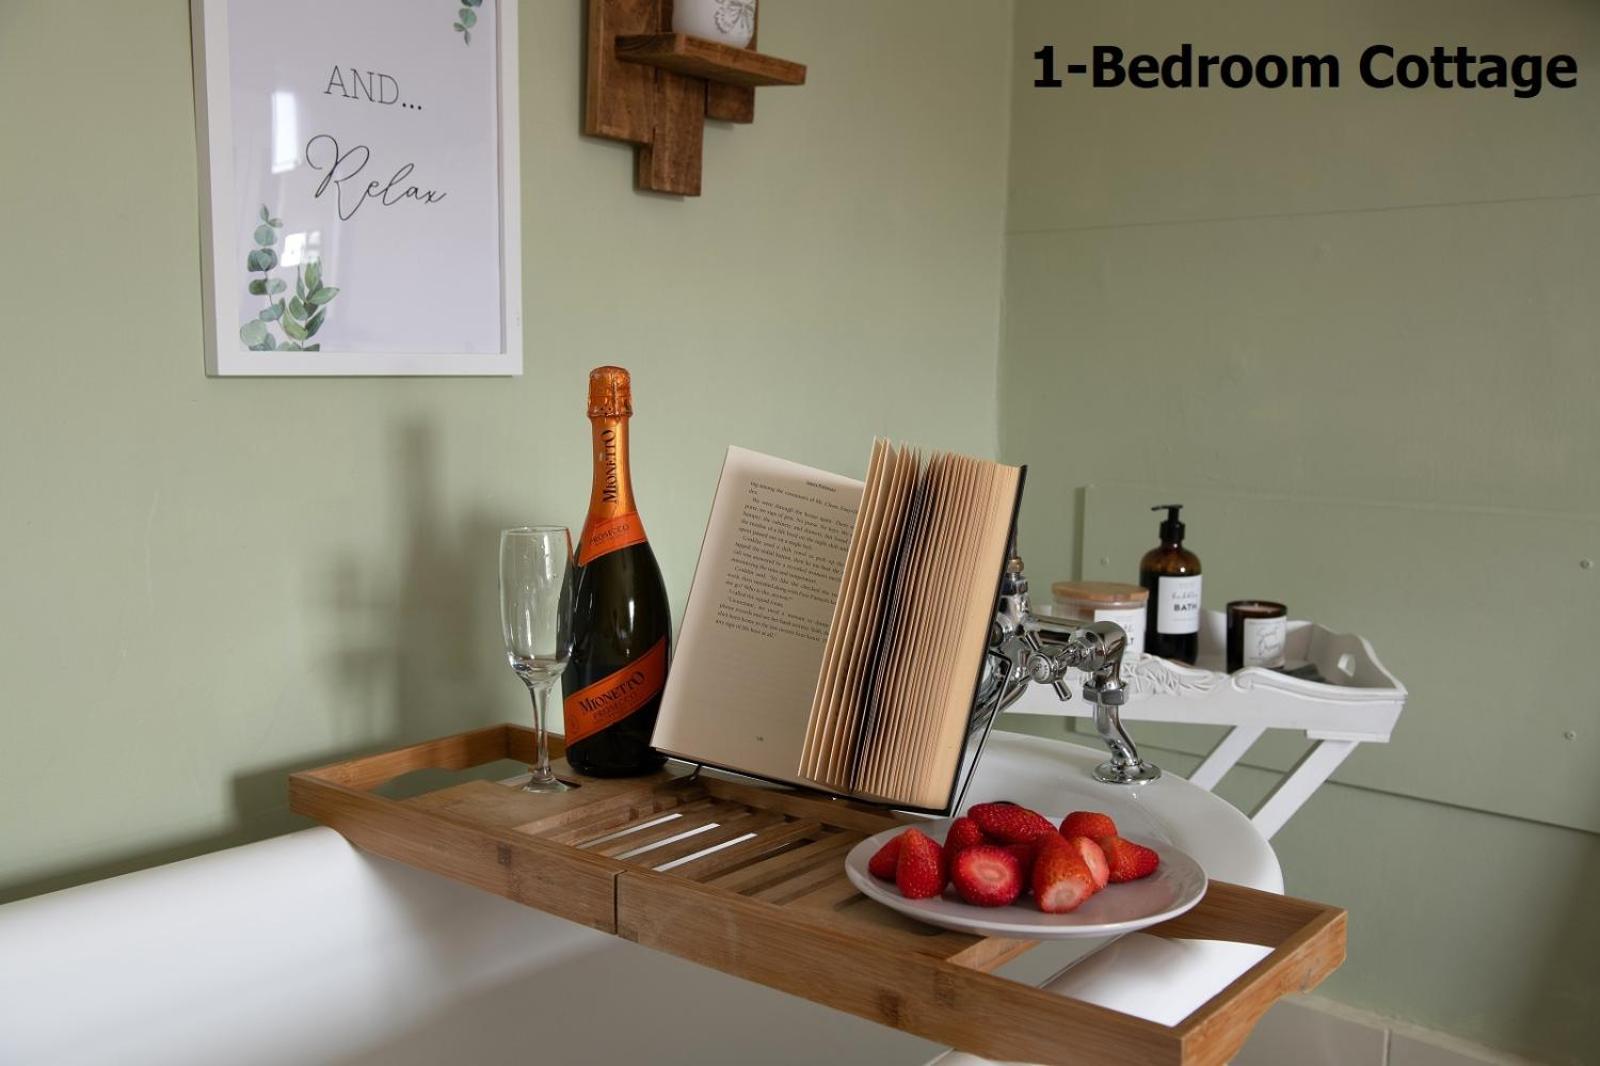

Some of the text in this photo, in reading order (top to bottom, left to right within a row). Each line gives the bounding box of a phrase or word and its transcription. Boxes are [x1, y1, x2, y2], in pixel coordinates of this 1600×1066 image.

[324, 65, 422, 110] AND...
[306, 135, 446, 221] Relax
[1174, 603, 1197, 612] BATH
